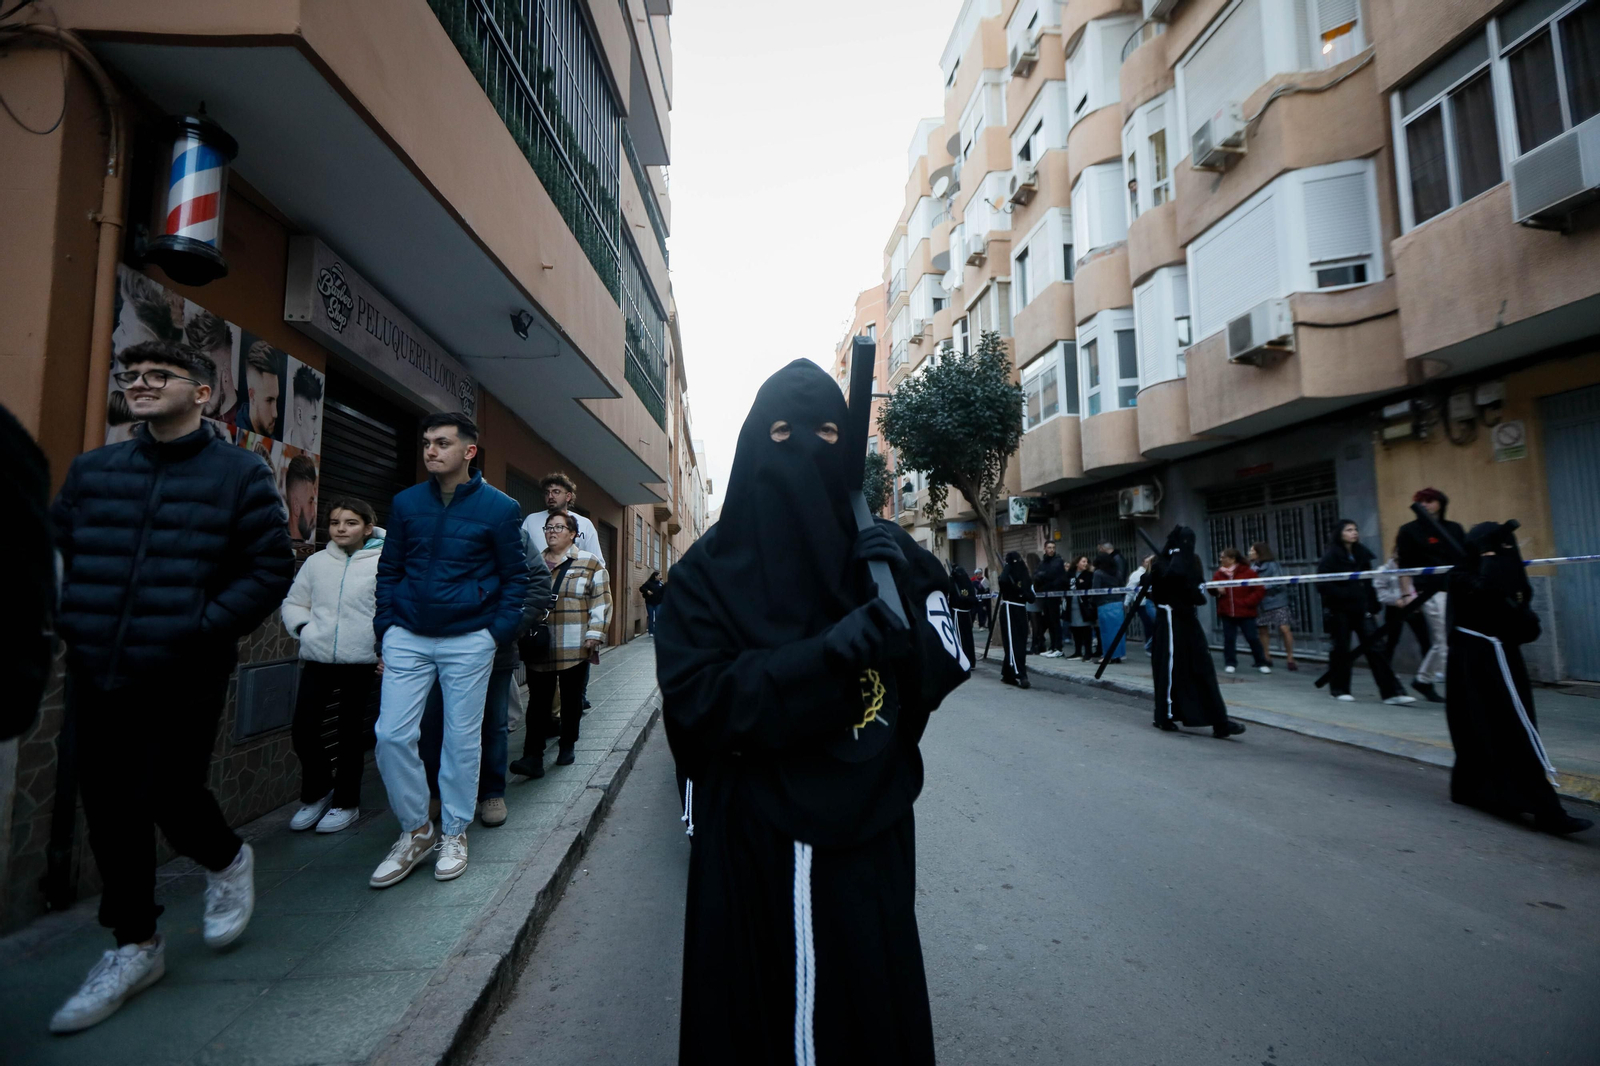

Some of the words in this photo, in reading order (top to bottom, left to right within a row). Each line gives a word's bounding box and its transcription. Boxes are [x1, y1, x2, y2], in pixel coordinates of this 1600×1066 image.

[317, 268, 353, 309] Barber
[328, 296, 347, 332] Shop
[356, 295, 432, 379] PELUQUERIA
[433, 358, 458, 397] LOOK
